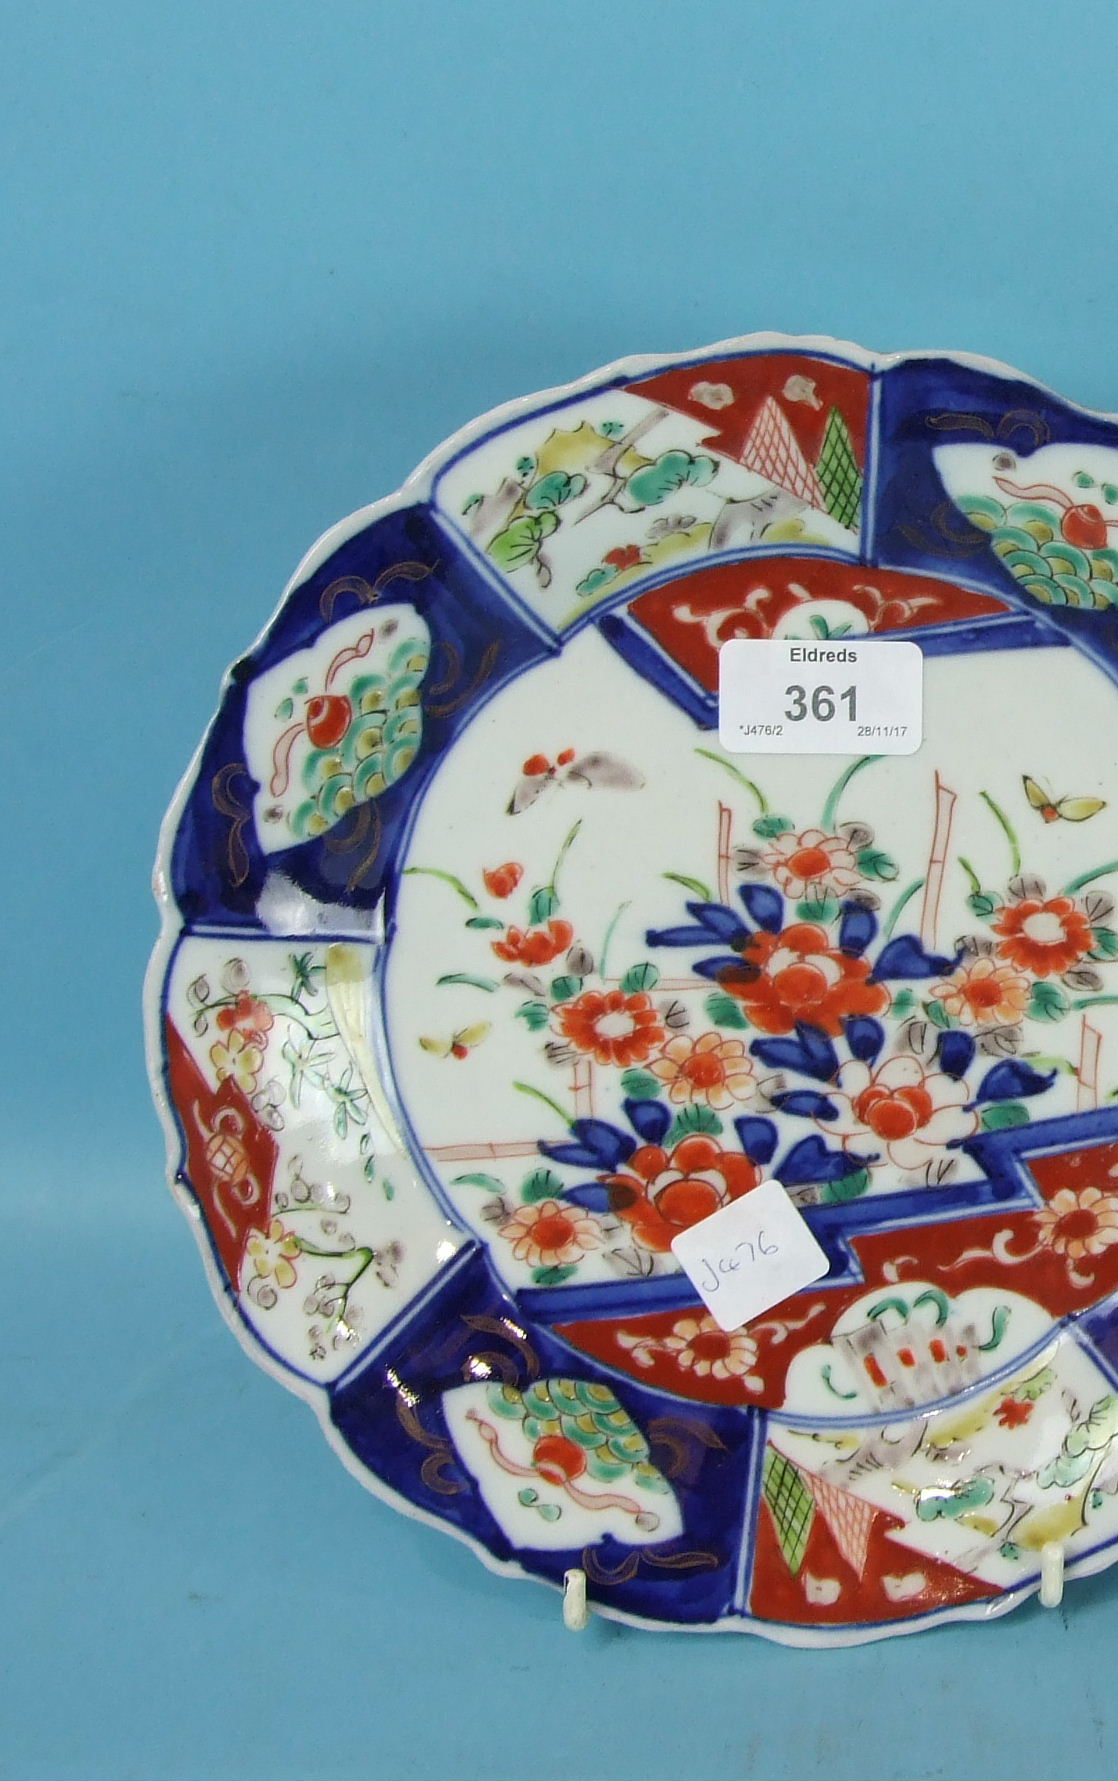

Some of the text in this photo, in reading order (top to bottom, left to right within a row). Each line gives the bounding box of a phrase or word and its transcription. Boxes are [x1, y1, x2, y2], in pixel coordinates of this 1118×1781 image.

[790, 647, 858, 663] Eldreds
[784, 684, 857, 722] 361
[857, 726, 908, 737] 28/11/17
